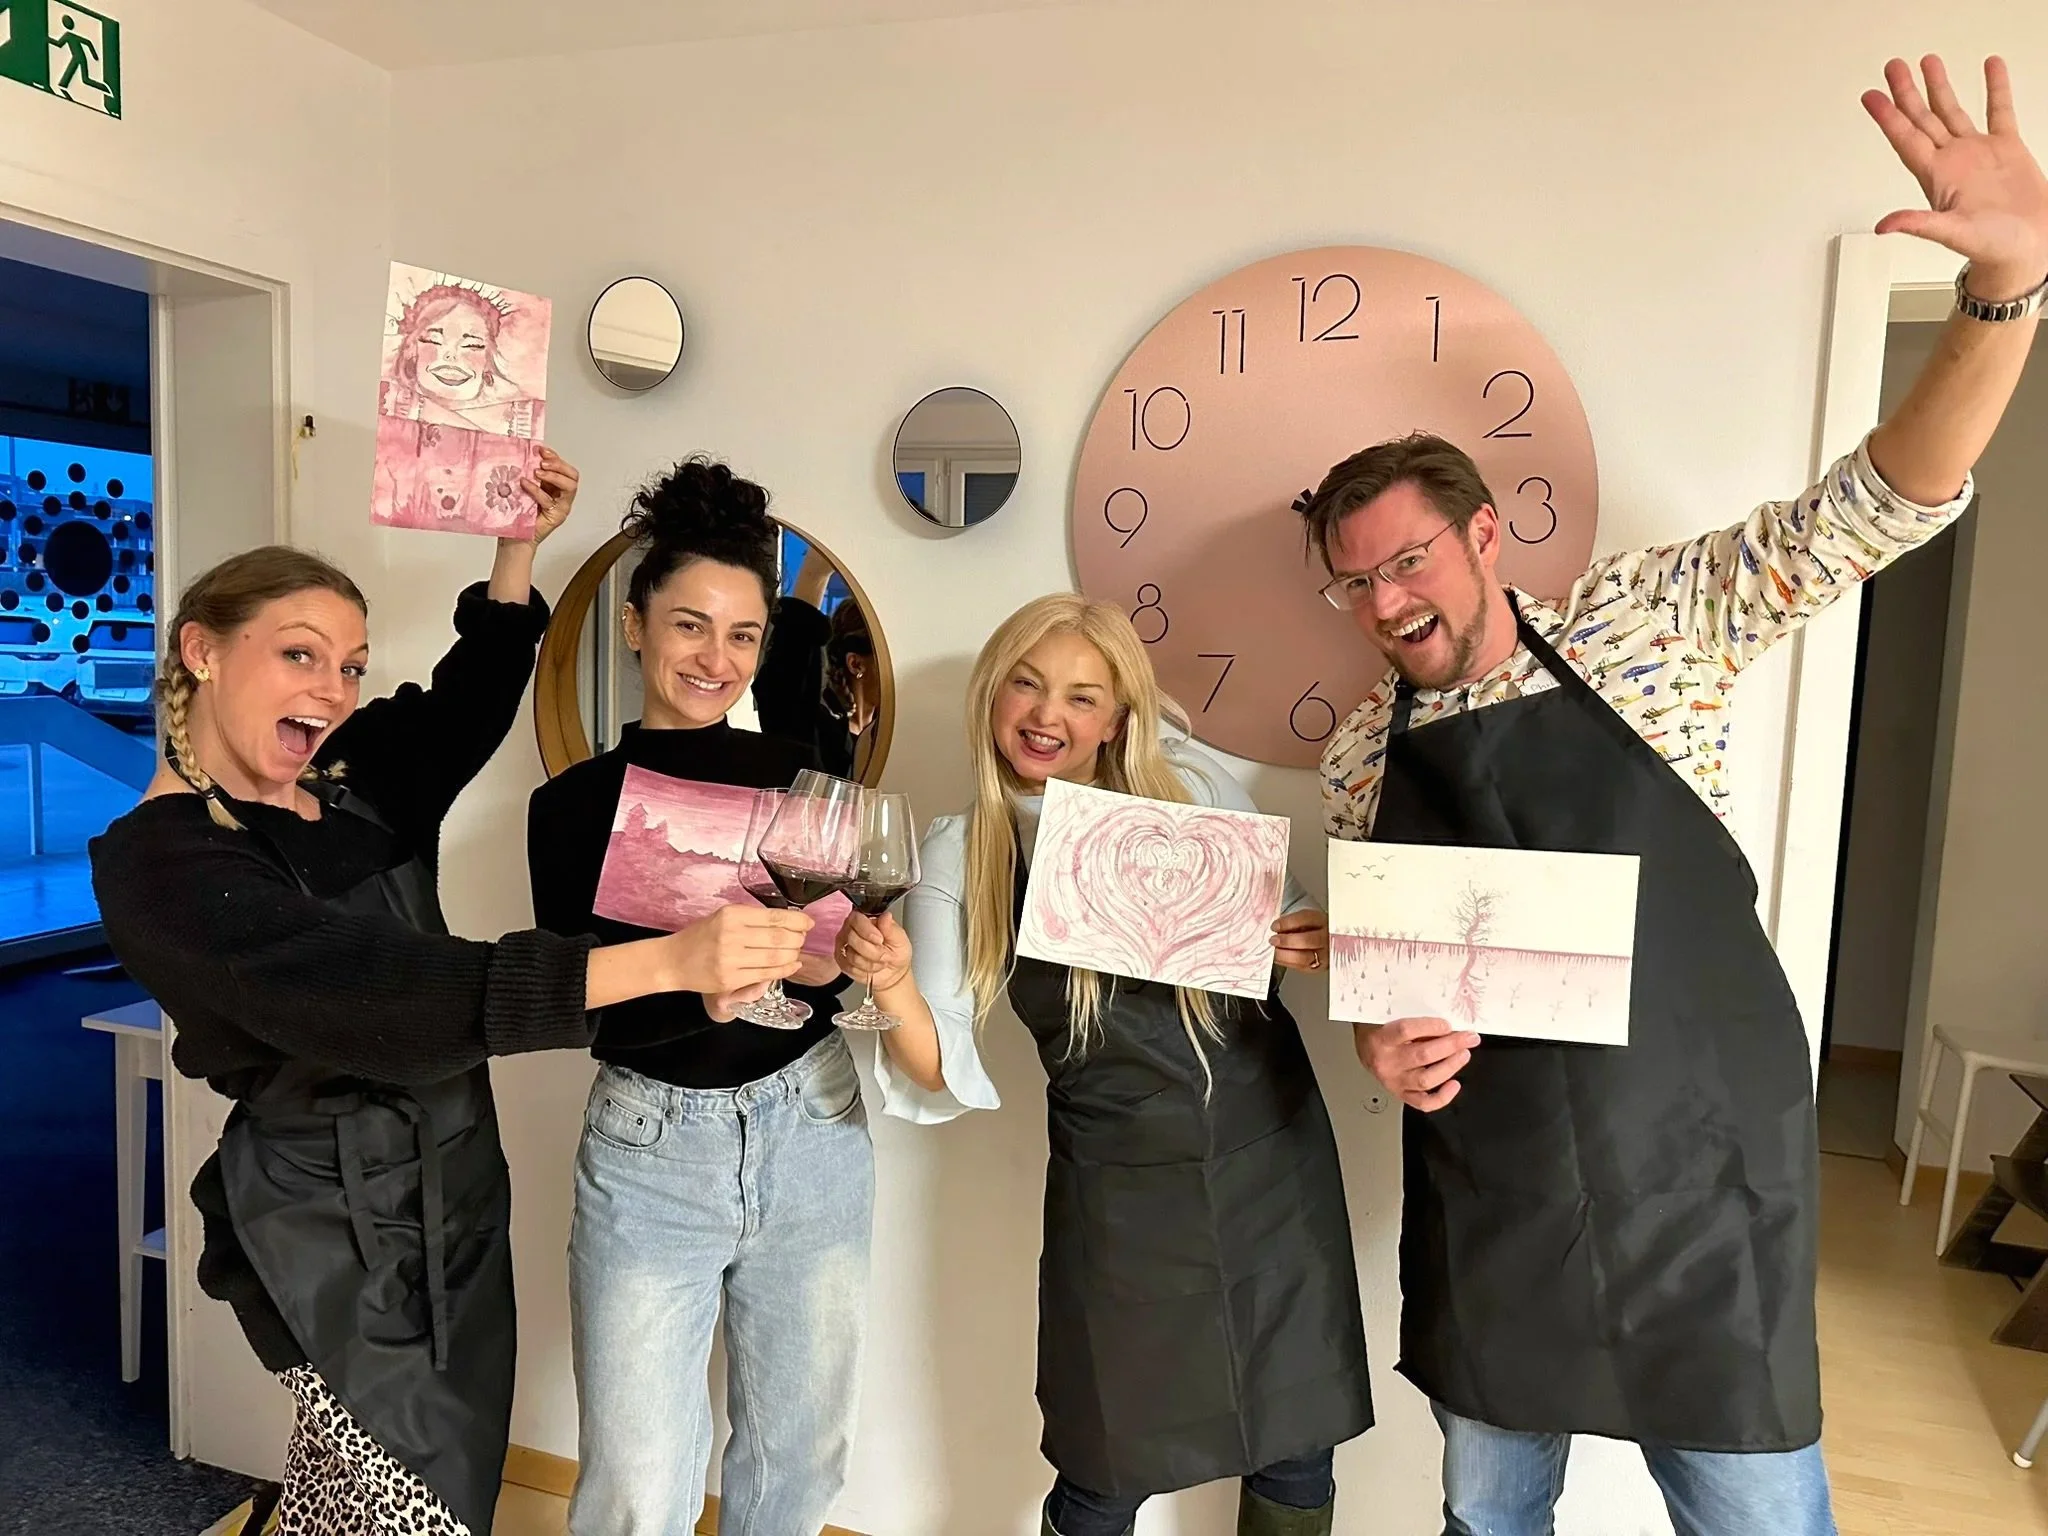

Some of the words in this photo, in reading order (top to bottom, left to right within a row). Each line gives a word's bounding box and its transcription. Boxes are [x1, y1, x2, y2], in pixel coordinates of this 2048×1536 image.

[1212, 308, 1246, 375] 11
[1292, 274, 1361, 343] 12
[1425, 295, 1440, 363] 1
[1123, 386, 1191, 451] 10
[1482, 370, 1535, 439] 2
[1104, 487, 1148, 549] 9
[1509, 476, 1557, 545] 3
[1130, 583, 1169, 643] 8
[1197, 653, 1237, 713] 7
[1289, 681, 1336, 742] 6
